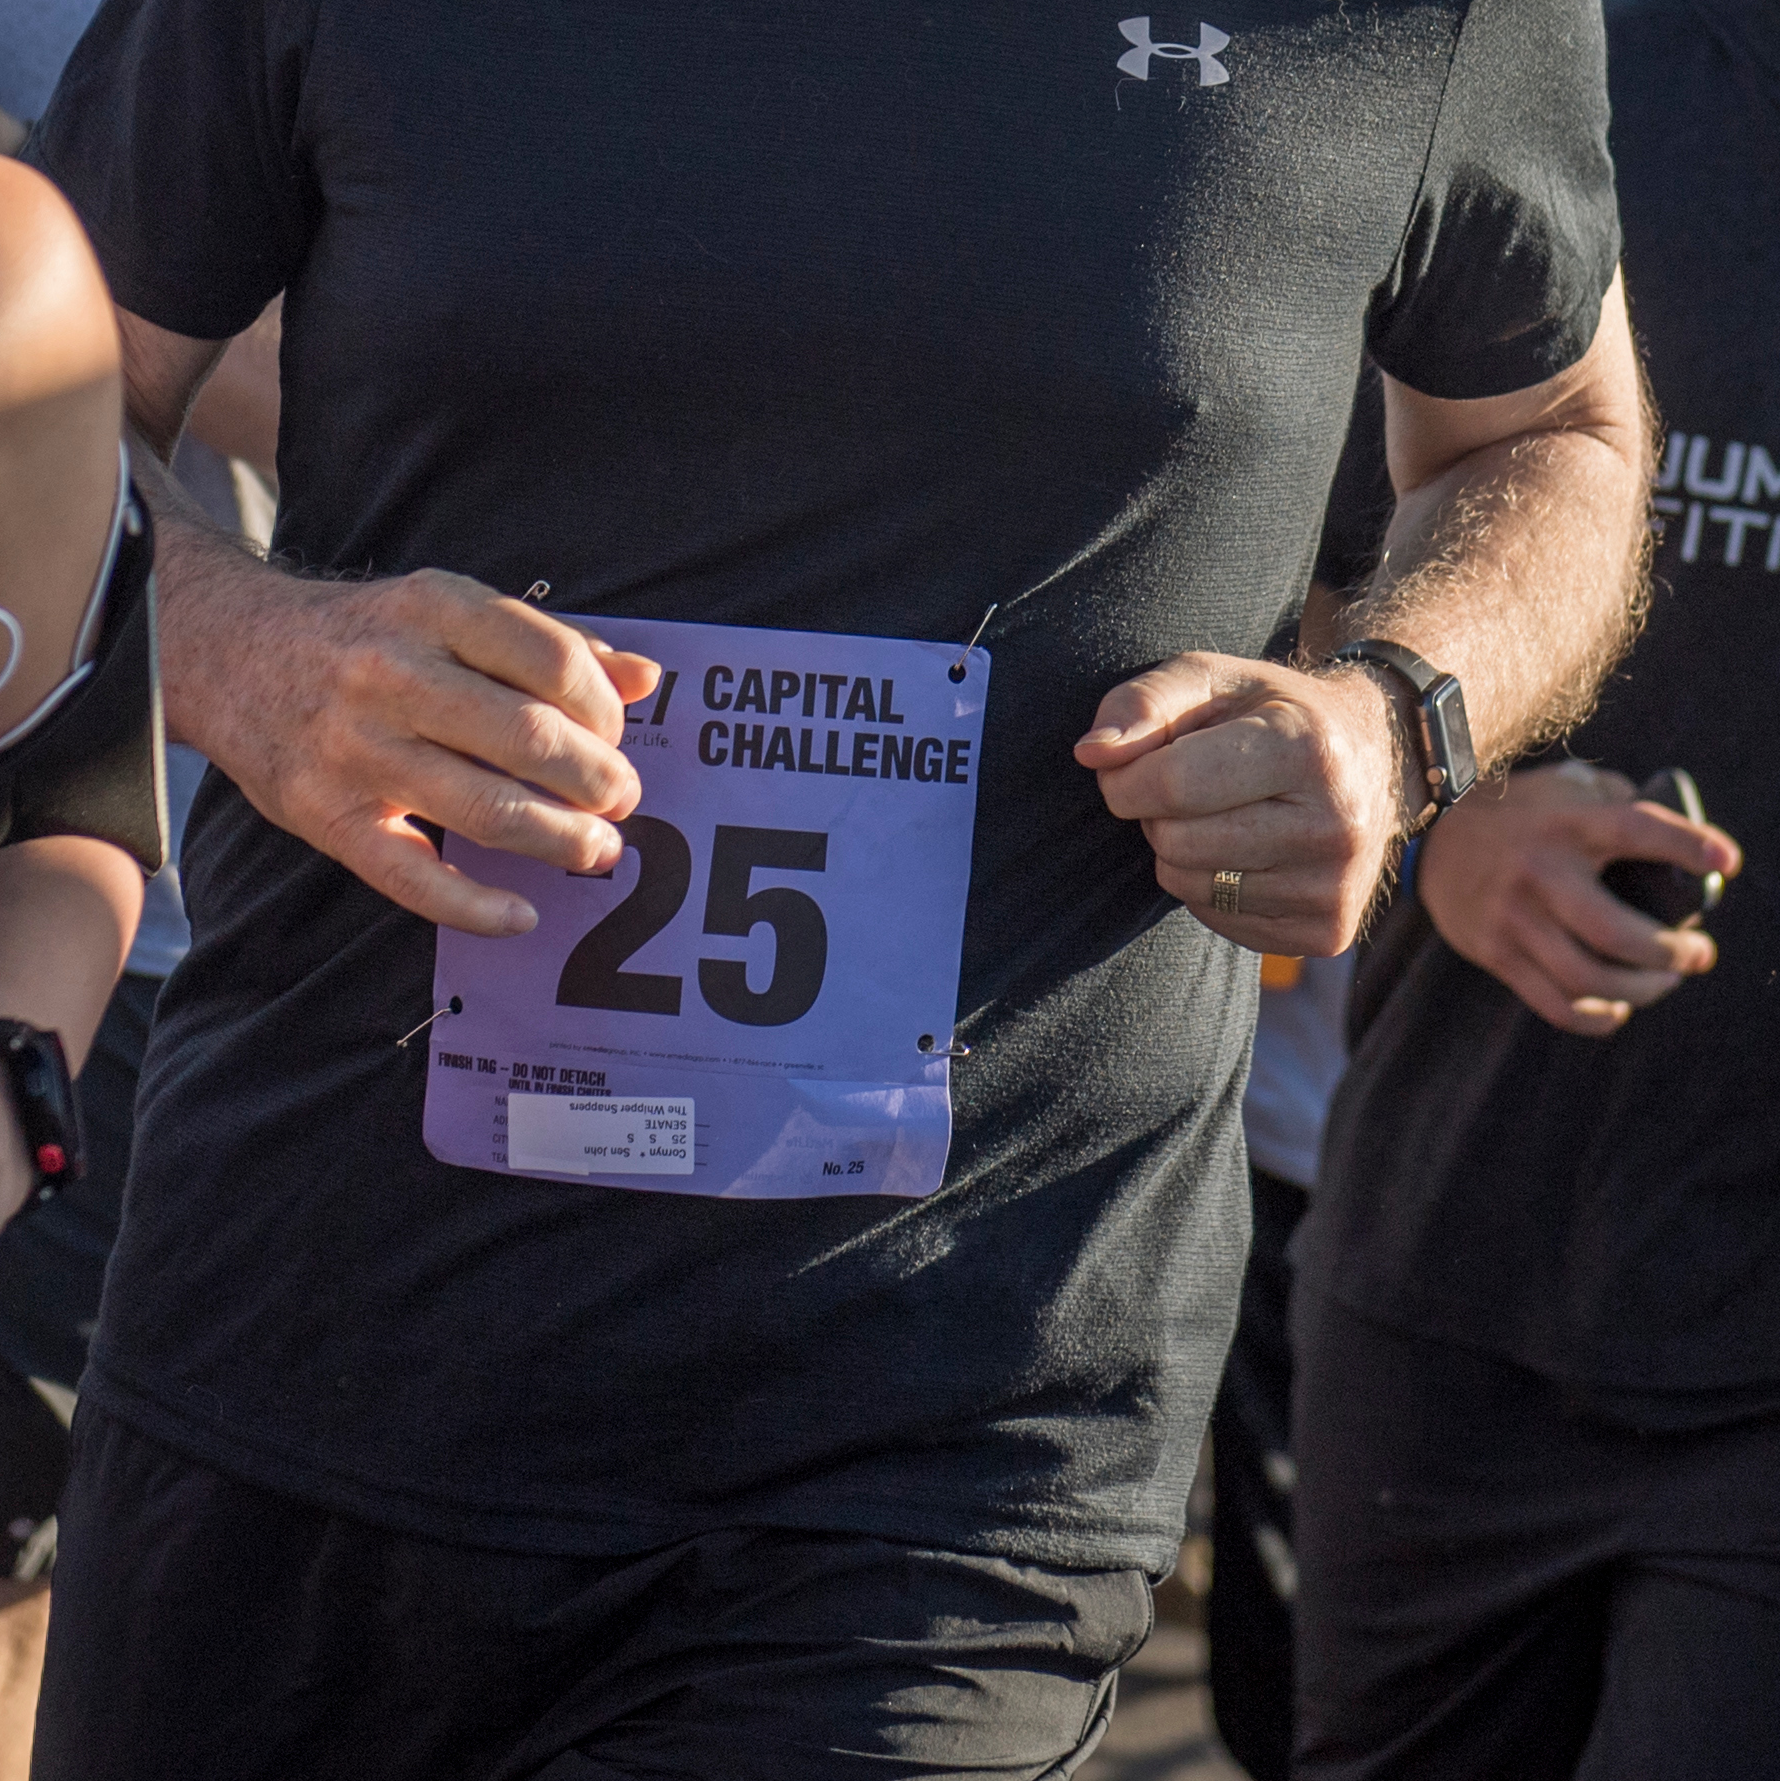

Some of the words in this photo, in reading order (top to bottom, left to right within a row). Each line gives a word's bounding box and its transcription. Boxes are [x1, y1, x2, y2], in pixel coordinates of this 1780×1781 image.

[703, 665, 905, 725] CAPITAL
[643, 732, 673, 749] Life.
[698, 720, 971, 785] CHALLENGE
[556, 813, 829, 1028] 25
[439, 1052, 473, 1071] FINISH
[477, 1057, 497, 1074] TAG
[513, 1062, 528, 1079] DO
[532, 1065, 556, 1082] NOT
[559, 1069, 606, 1087] DETACH
[509, 1078, 531, 1091] UNTIL
[535, 1082, 544, 1092] IN
[546, 1083, 574, 1095] FINISH
[569, 1102, 618, 1114] Snappers
[620, 1102, 665, 1115] Whipper
[668, 1105, 687, 1115] The
[644, 1119, 687, 1130] SENATE
[671, 1133, 687, 1144] 25
[584, 1145, 607, 1157] John
[610, 1146, 631, 1158] Sen
[649, 1147, 687, 1158] Cornyn
[822, 1161, 843, 1176] No.
[847, 1160, 865, 1175] 25
